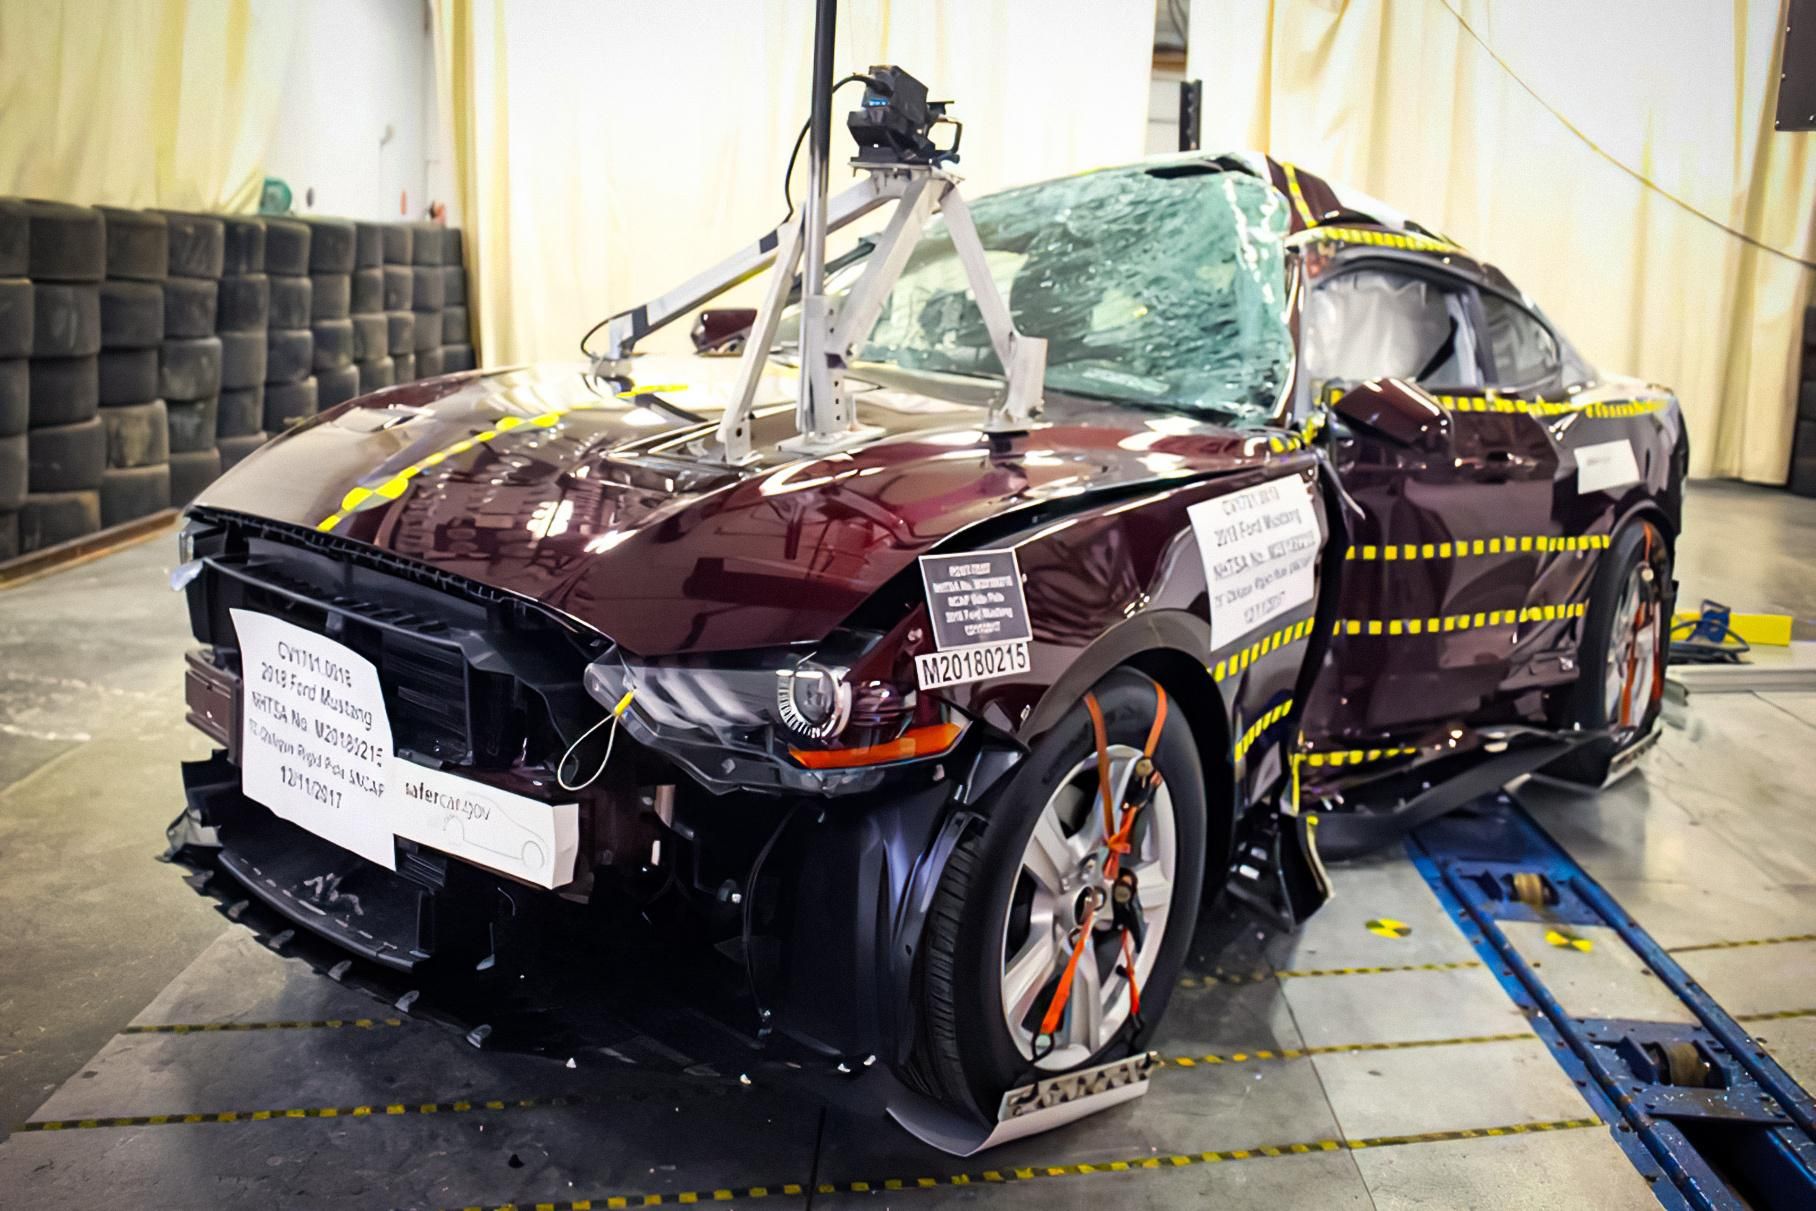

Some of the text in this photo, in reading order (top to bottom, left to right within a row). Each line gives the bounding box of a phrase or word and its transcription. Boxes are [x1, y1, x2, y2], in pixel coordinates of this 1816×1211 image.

[922, 643, 1027, 686] M20180215
[290, 673, 317, 701] Ford
[320, 686, 373, 732] Mustang
